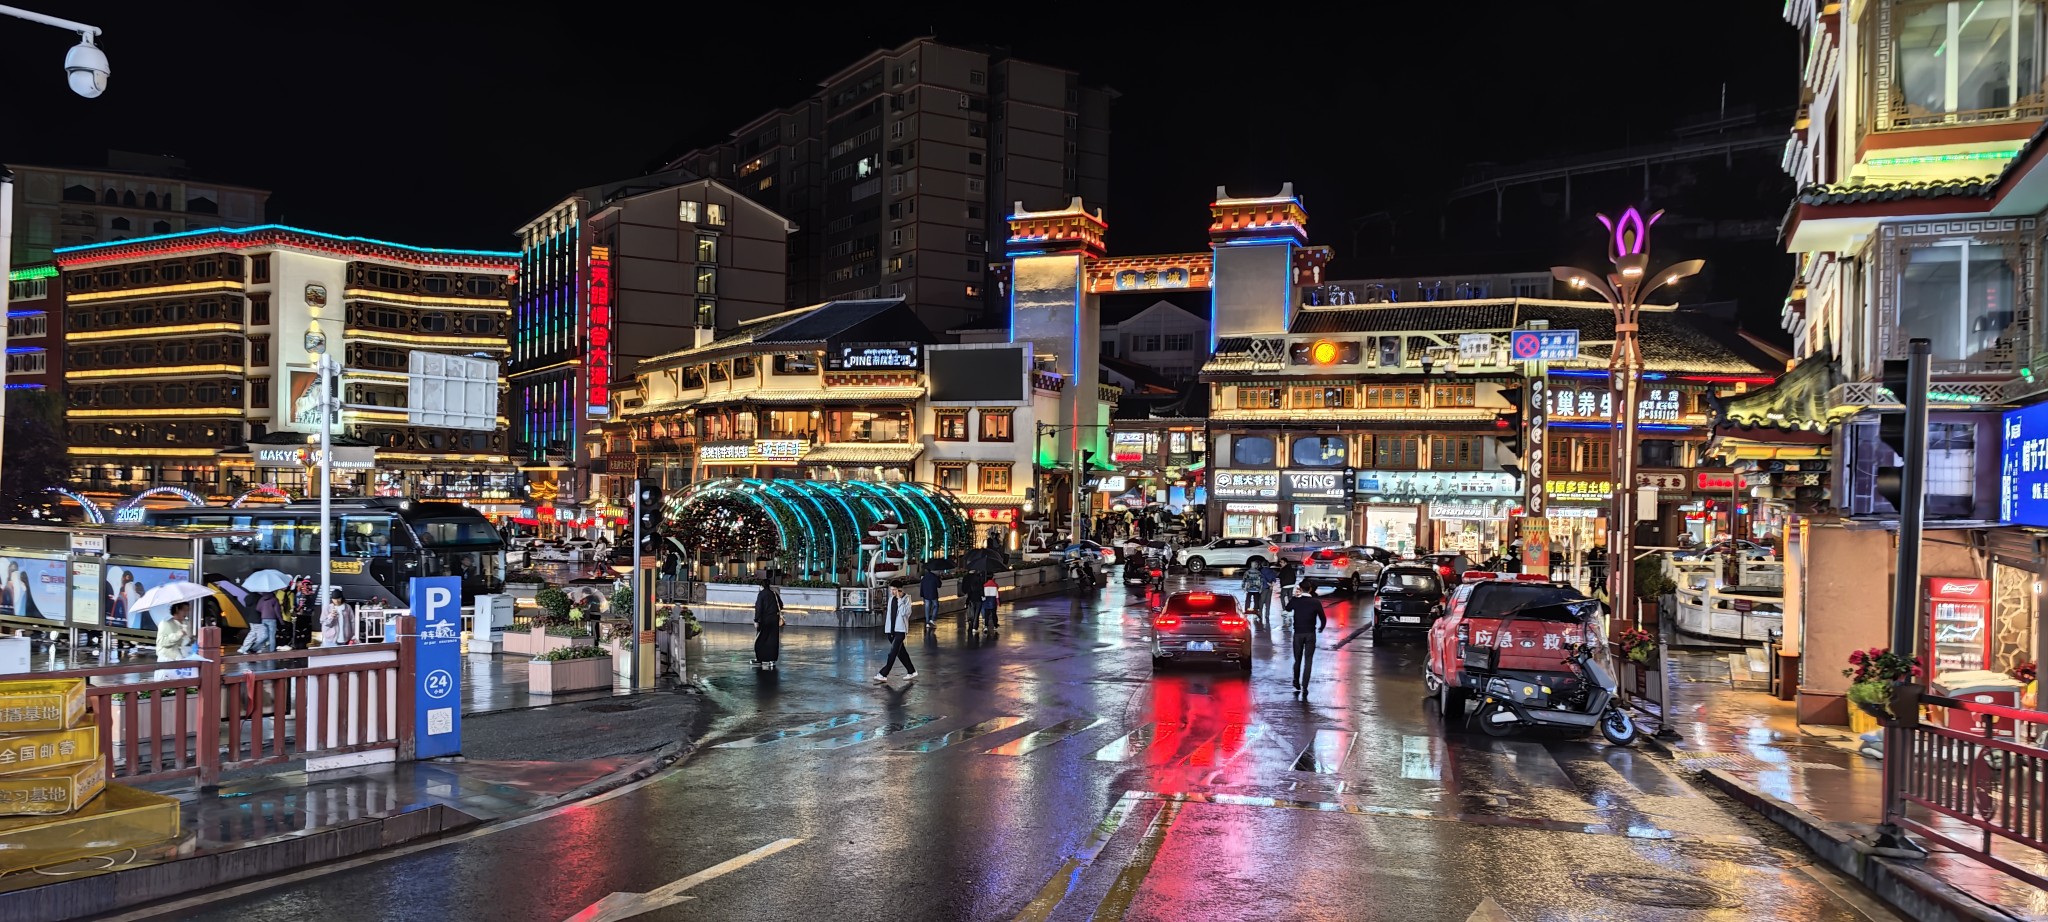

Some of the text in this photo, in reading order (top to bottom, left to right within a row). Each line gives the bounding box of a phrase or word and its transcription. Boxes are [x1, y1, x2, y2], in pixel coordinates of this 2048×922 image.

[1121, 271, 1182, 287] 溜溜城
[1541, 349, 1575, 359] 禁止停车
[426, 587, 451, 621] P
[1475, 630, 1583, 650] 应急 救援
[429, 675, 448, 689] 24
[0, 706, 60, 722] 播基地
